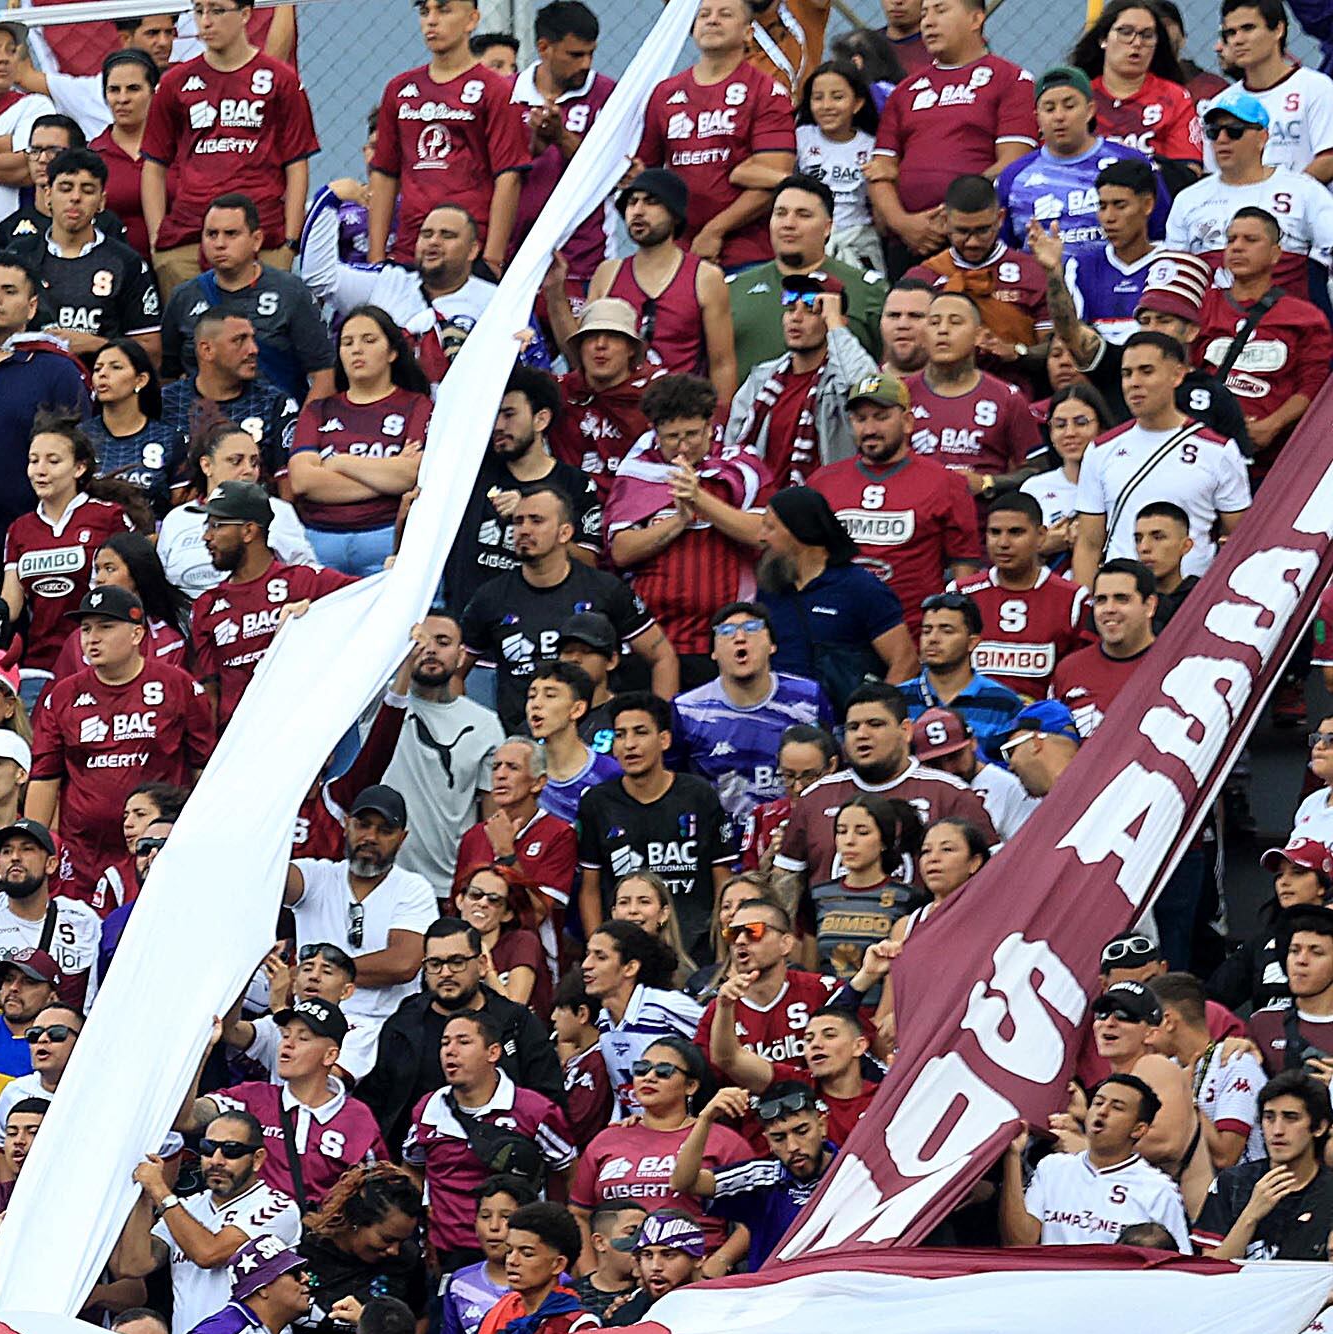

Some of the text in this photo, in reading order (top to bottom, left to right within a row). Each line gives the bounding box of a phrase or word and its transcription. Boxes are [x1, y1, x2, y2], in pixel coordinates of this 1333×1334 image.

[937, 86, 978, 100] BAC
[220, 100, 264, 121] BAC
[698, 109, 735, 131] BAC
[196, 138, 258, 154] LIBERTY
[672, 149, 730, 165] LIBERTY
[59, 307, 102, 328] BAC
[941, 430, 982, 449] BAC
[844, 518, 905, 539] IMBO
[22, 552, 79, 571] BIMBO
[976, 649, 1048, 670] BIMBO
[114, 712, 156, 733] BAC
[113, 732, 156, 742] CREDOMATIC
[86, 752, 149, 768] LIBERTY
[648, 845, 696, 865] BAC
[637, 1157, 677, 1171] BA
[602, 1184, 680, 1200] LIBERT
